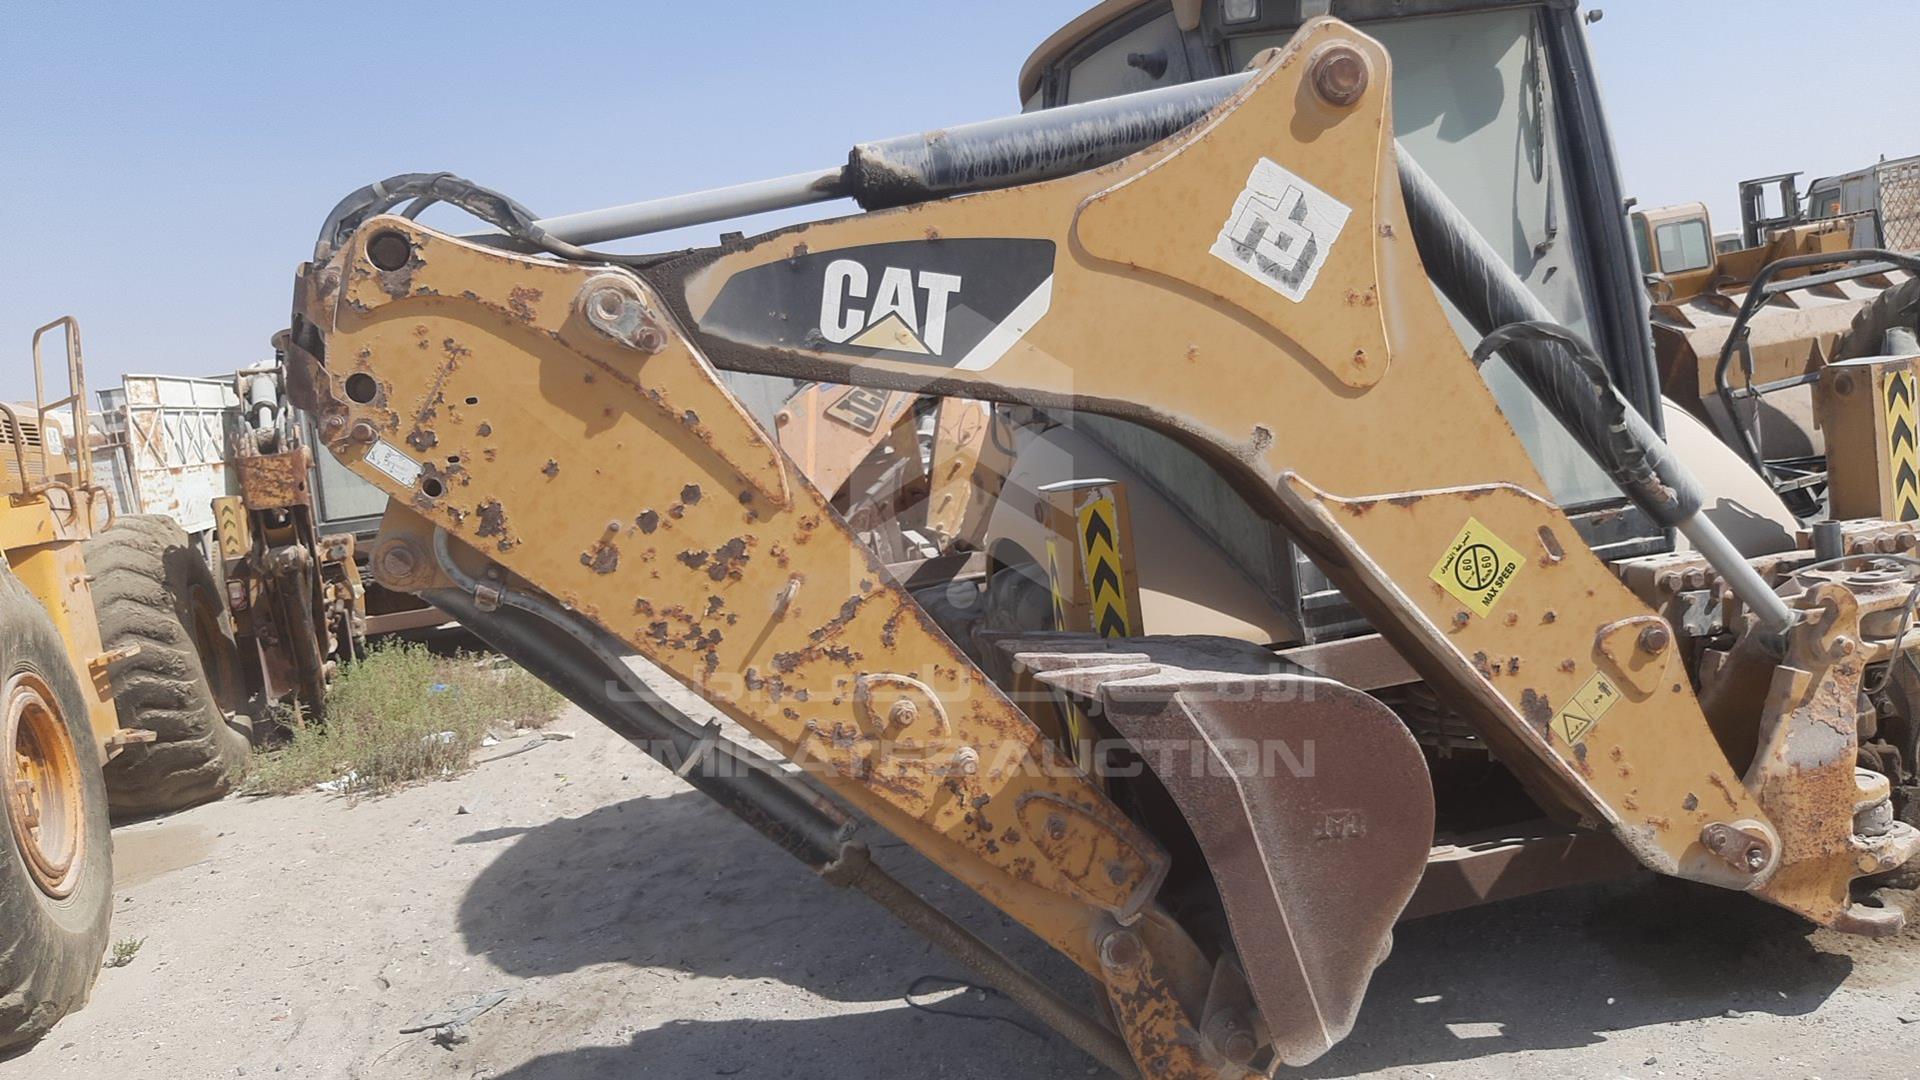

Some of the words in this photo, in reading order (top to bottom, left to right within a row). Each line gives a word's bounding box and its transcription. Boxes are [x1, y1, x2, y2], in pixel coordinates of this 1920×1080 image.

[820, 259, 961, 356] CAT
[1462, 559, 1472, 571] 60
[1481, 556, 1492, 568] 60
[1482, 587, 1499, 606] MAX
[1496, 562, 1516, 588] SPEED
